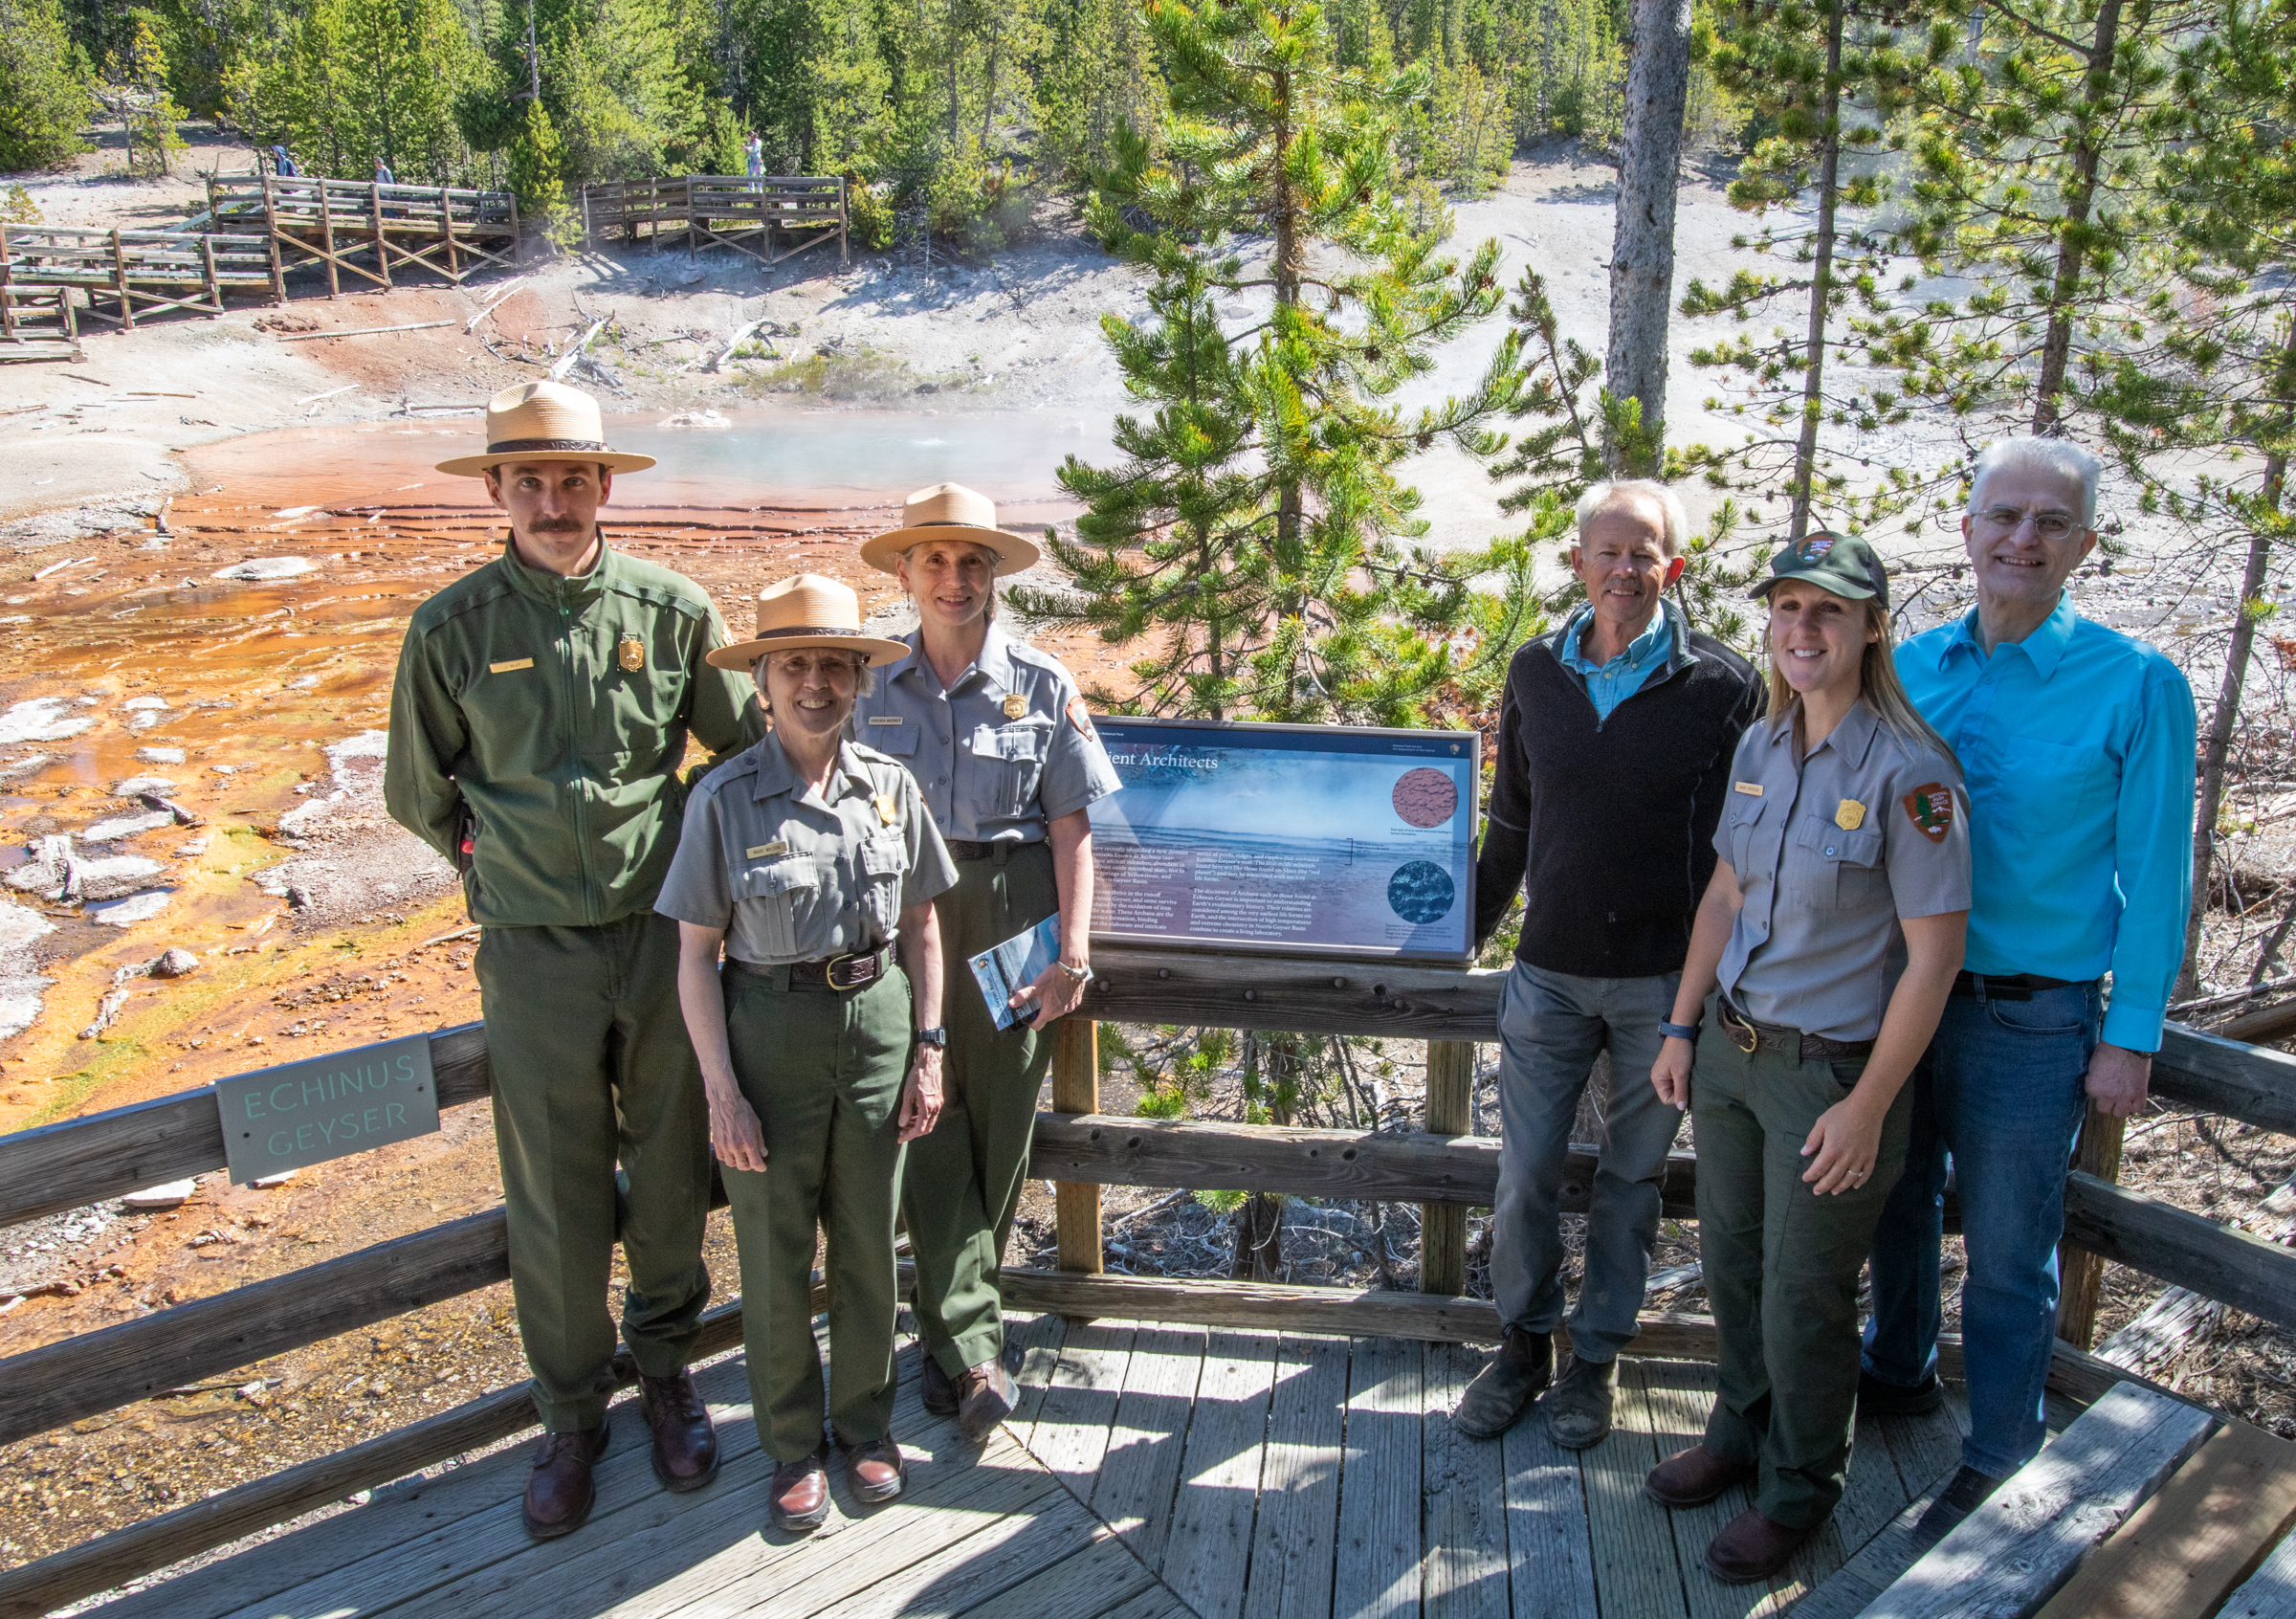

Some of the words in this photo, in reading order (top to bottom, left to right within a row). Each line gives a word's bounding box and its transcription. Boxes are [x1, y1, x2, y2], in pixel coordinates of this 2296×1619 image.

[1109, 752, 1136, 765] ient
[1139, 753, 1218, 768] Architects
[1928, 790, 1949, 799] NATIONAL
[1931, 799, 1949, 808] SERVICE
[992, 991, 1001, 1008] Geyser
[244, 1055, 415, 1120] ECHINUS
[268, 1103, 407, 1156] GEYSER
